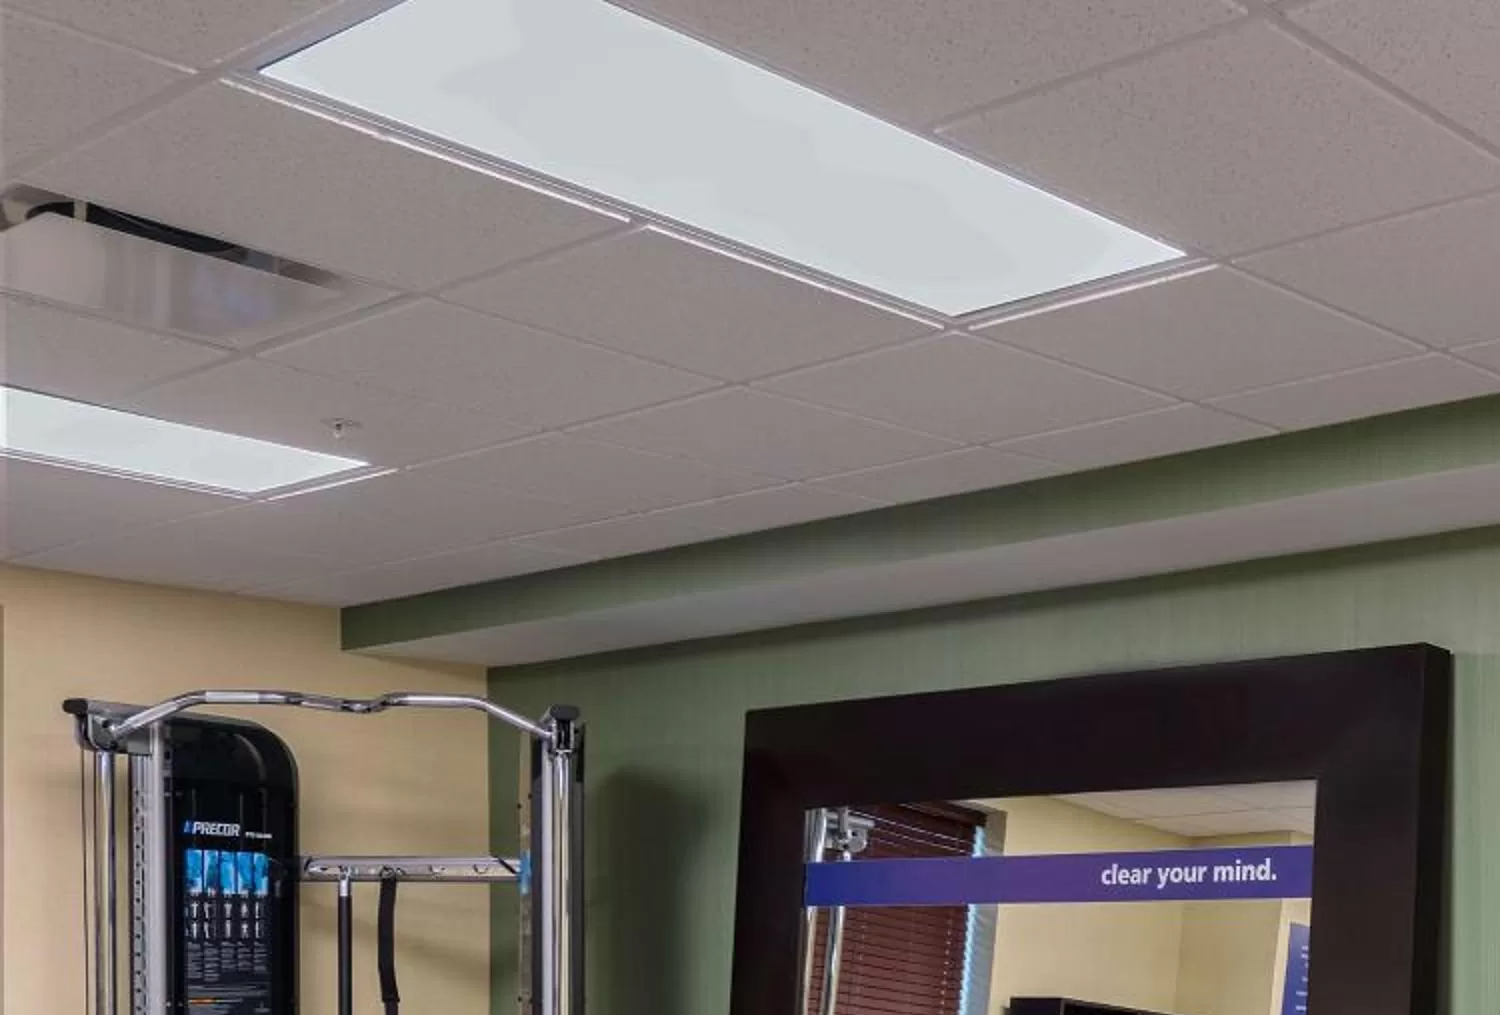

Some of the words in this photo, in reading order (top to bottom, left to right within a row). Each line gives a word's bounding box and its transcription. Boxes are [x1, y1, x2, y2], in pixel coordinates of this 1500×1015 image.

[192, 821, 241, 836] PRECOR
[1101, 863, 1152, 885] clear
[1157, 864, 1207, 889] your
[1213, 858, 1277, 882] mind.
